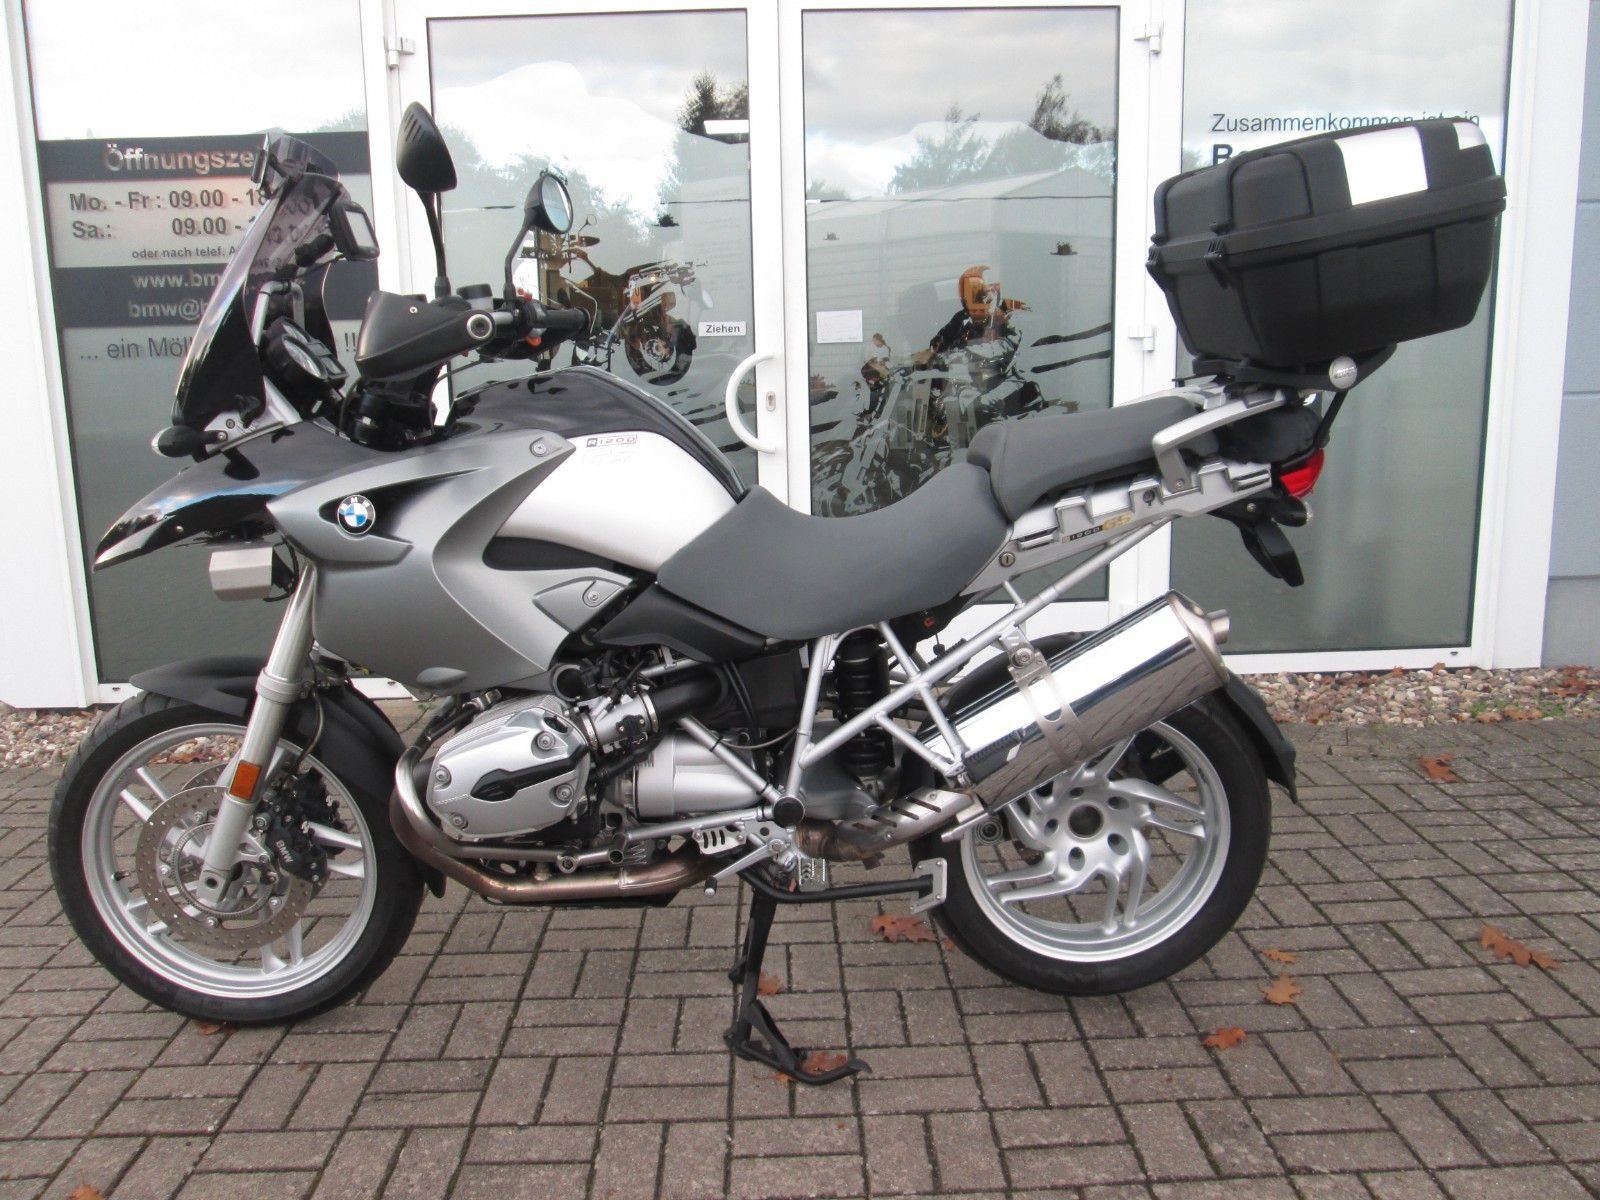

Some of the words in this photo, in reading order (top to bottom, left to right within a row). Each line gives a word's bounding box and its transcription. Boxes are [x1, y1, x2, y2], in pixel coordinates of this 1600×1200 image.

[1212, 112, 1413, 132] Zusammenkomm
[105, 143, 255, 174] Öffnungsze
[70, 193, 108, 211] Mo.
[169, 188, 224, 208] 09.00
[72, 220, 112, 239] Sa.:
[172, 216, 227, 235] 09.00
[132, 248, 157, 259] oder
[162, 246, 192, 258] nach
[195, 246, 225, 257] telef.
[133, 268, 221, 288] www.bm
[705, 324, 741, 334] Ziehen
[107, 338, 140, 359] ein
